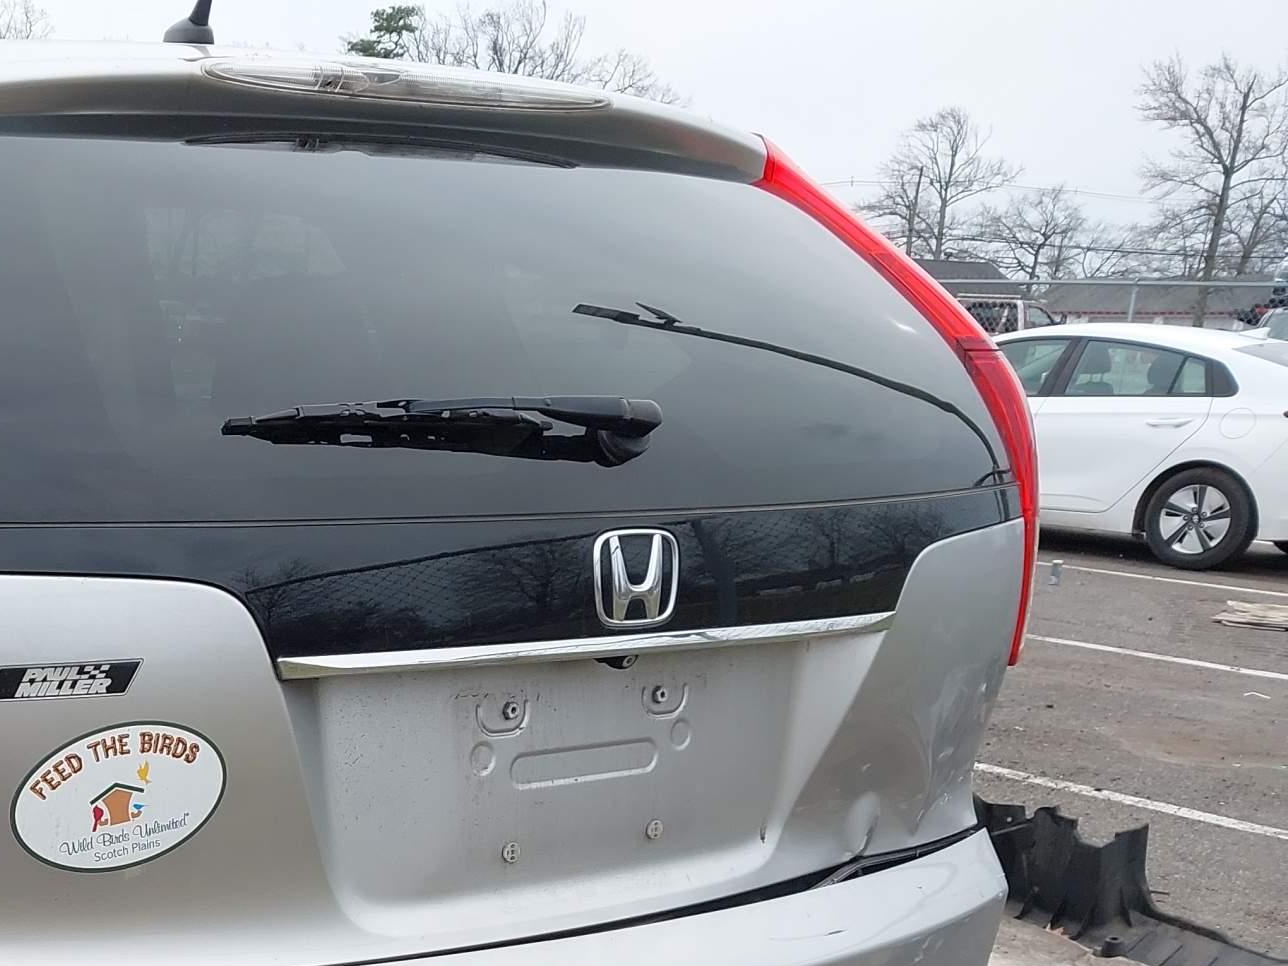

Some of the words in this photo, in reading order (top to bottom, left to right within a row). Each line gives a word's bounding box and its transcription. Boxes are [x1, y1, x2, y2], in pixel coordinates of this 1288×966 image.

[22, 666, 83, 682] PAUL
[14, 678, 112, 698] MILLER
[29, 753, 83, 801] FEED
[87, 733, 130, 762] THE
[139, 731, 200, 764] BIRDS
[59, 837, 95, 856] Wild
[97, 828, 131, 847] Birds
[94, 847, 129, 862] Scotch
[132, 839, 161, 854] Plains
